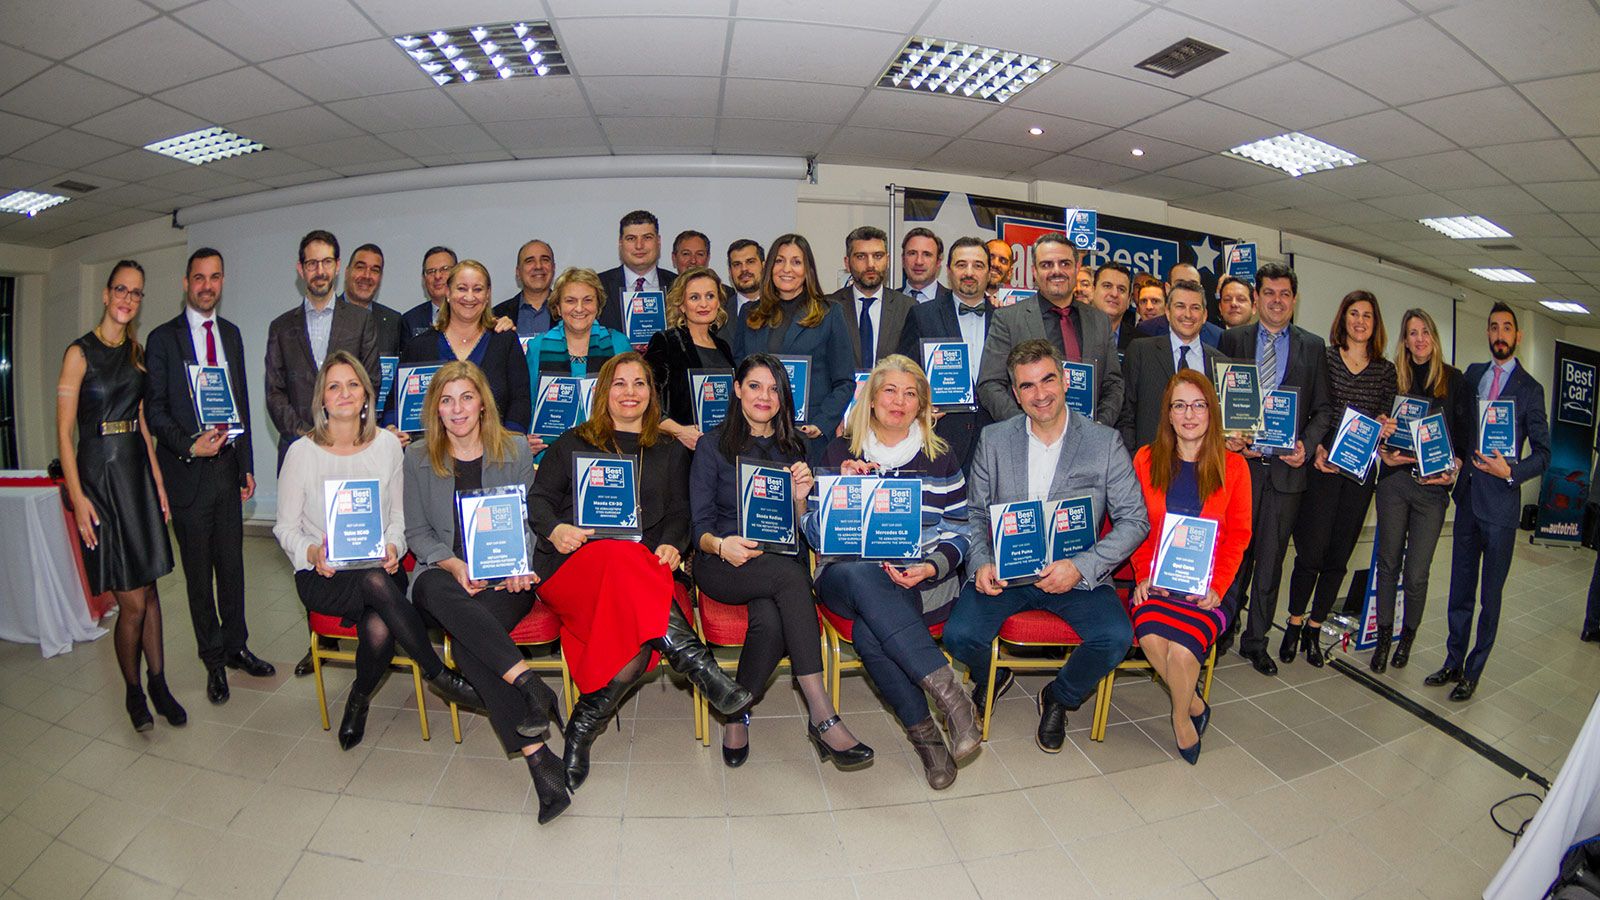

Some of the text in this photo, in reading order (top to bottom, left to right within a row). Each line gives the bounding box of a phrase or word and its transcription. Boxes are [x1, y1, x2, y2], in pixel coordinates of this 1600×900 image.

[1090, 237, 1162, 280] Best
[1566, 363, 1593, 387] Best
[1568, 384, 1588, 401] car
[605, 467, 622, 475] Best
[767, 477, 782, 486] Best
[353, 490, 369, 498] Best
[1017, 511, 1033, 519] Best
